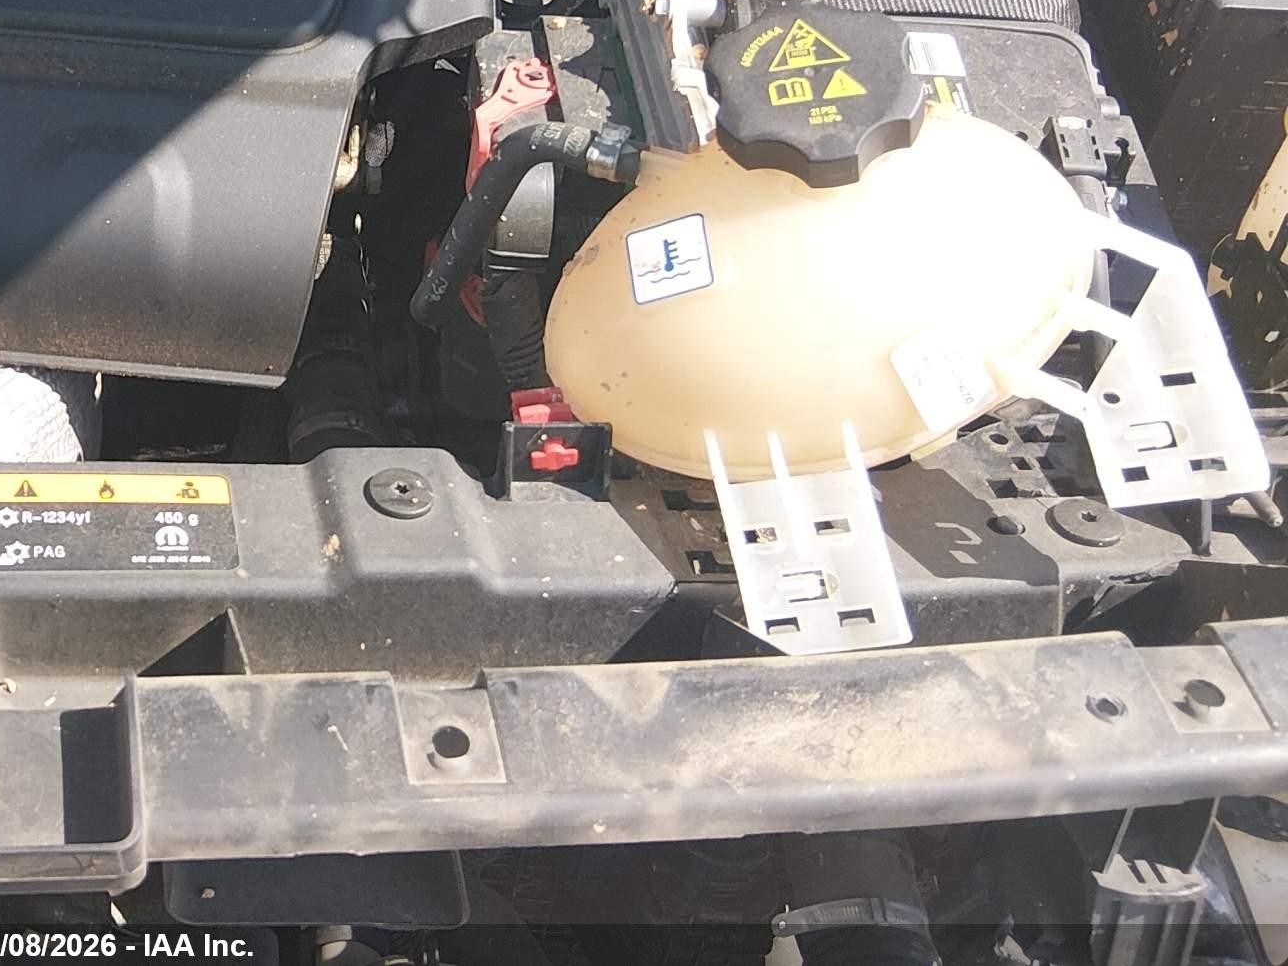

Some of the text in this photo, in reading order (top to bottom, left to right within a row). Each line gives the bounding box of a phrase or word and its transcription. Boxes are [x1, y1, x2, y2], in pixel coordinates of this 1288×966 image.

[154, 511, 183, 524] 450
[187, 513, 199, 527] g
[33, 544, 66, 558] PAG
